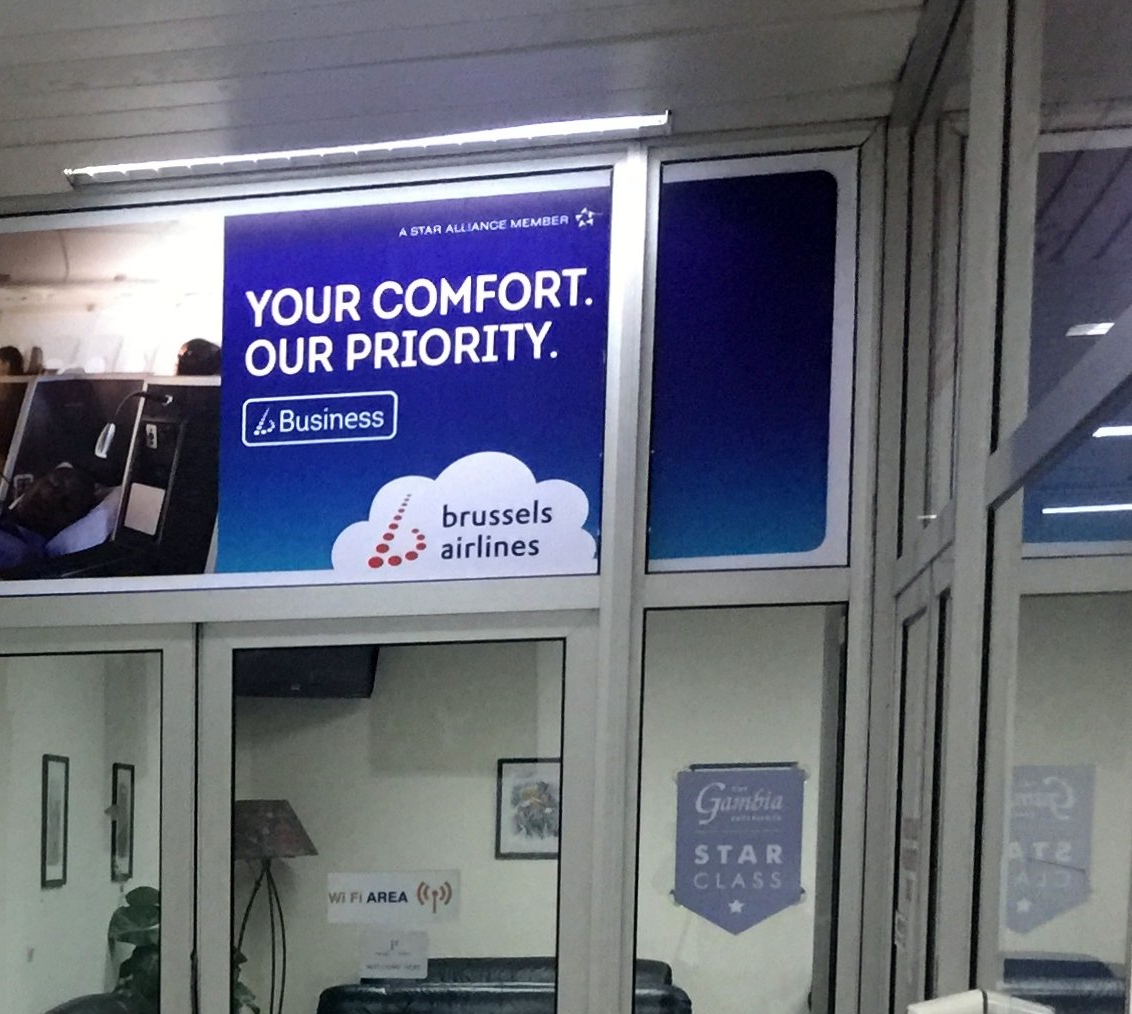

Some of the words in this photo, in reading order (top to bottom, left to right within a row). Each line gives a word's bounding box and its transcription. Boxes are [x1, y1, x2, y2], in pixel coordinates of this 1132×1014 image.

[399, 228, 407, 237] A
[410, 225, 442, 237] STAR
[445, 219, 508, 234] ALLIANCE
[510, 215, 569, 229] MEMBER
[245, 284, 361, 328] YOUR
[372, 268, 593, 320] COMFORT.
[244, 336, 334, 377] OUR
[346, 321, 558, 371] PRIORITY.
[279, 407, 385, 434] Business
[442, 500, 553, 528] brussels
[440, 537, 540, 561] airlines
[695, 782, 784, 825] Gambia
[694, 844, 783, 865] STAR
[693, 871, 783, 889] CLASS
[328, 892, 345, 904] Wi
[366, 891, 408, 904] AREA
